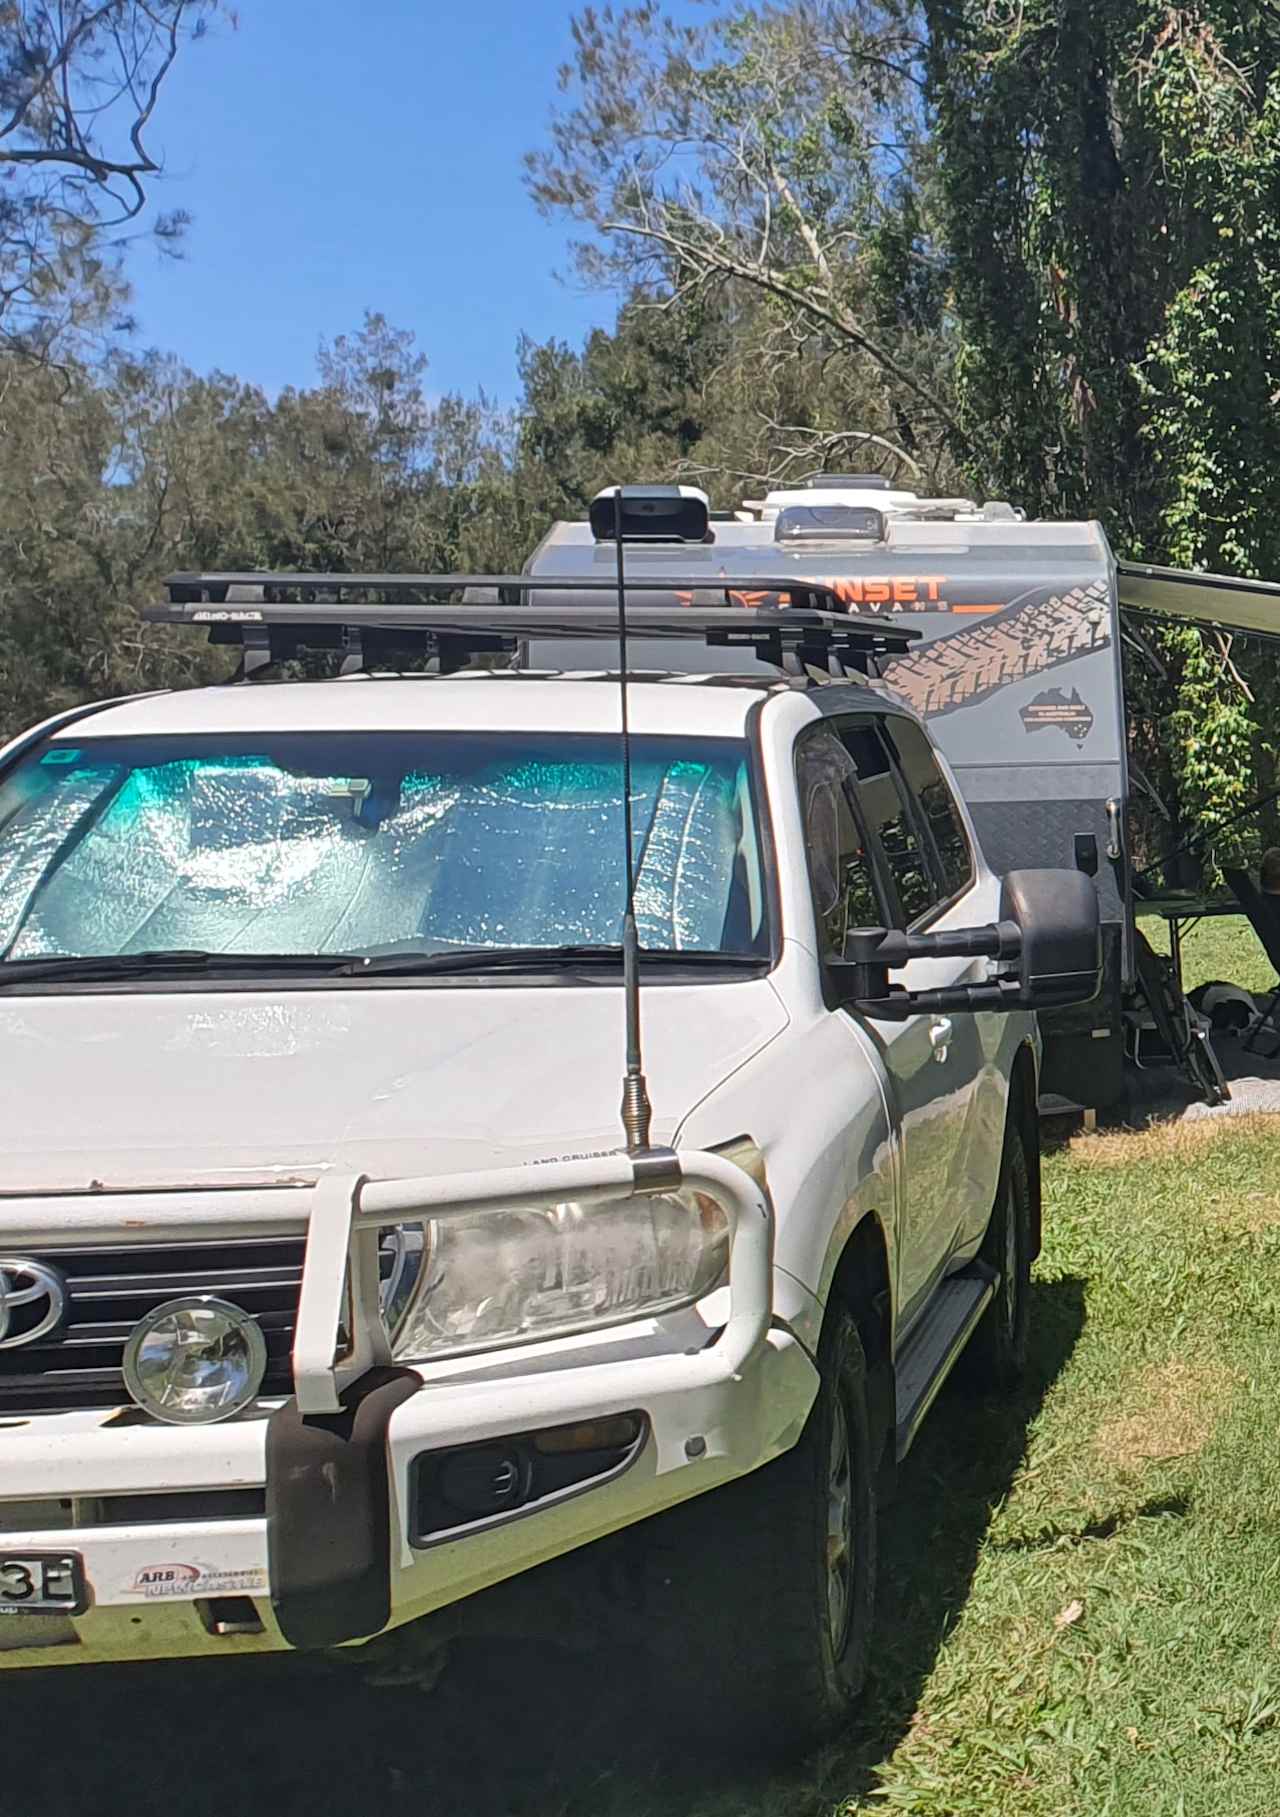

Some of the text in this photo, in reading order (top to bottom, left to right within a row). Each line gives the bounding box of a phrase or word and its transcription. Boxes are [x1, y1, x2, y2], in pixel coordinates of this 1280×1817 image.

[800, 576, 946, 602] NSET
[847, 601, 948, 613] AVANS
[139, 1570, 176, 1584] ARB
